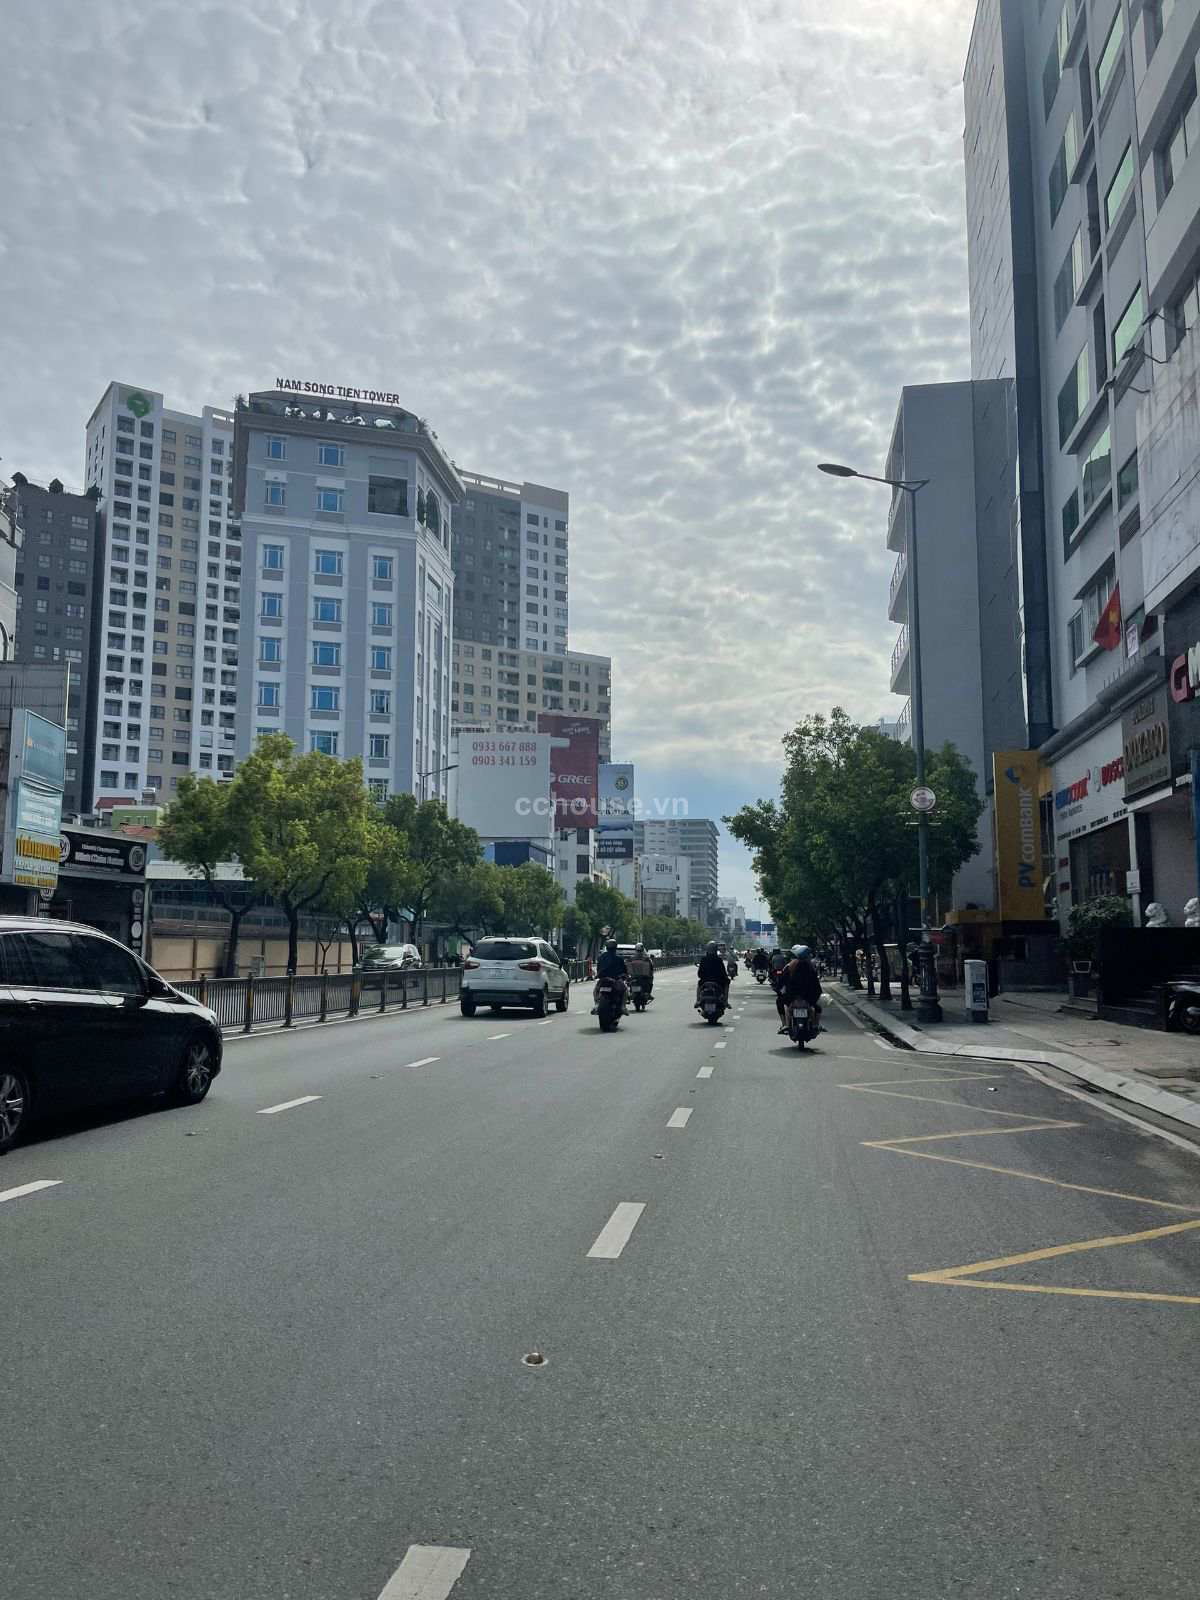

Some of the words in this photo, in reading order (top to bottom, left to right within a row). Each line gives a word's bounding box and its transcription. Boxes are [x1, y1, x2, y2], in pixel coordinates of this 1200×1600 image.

[276, 378, 302, 390] NAM
[304, 381, 335, 395] SONG
[337, 386, 361, 399] TIEN
[362, 390, 400, 404] TOWER
[472, 742, 496, 752] 0933
[499, 742, 516, 752] 667
[519, 742, 537, 752] 888
[472, 756, 496, 766] 0903
[498, 756, 516, 766] 341
[519, 756, 537, 766] 159
[557, 775, 593, 785] GREE
[1018, 786, 1036, 889] PVcomBank
